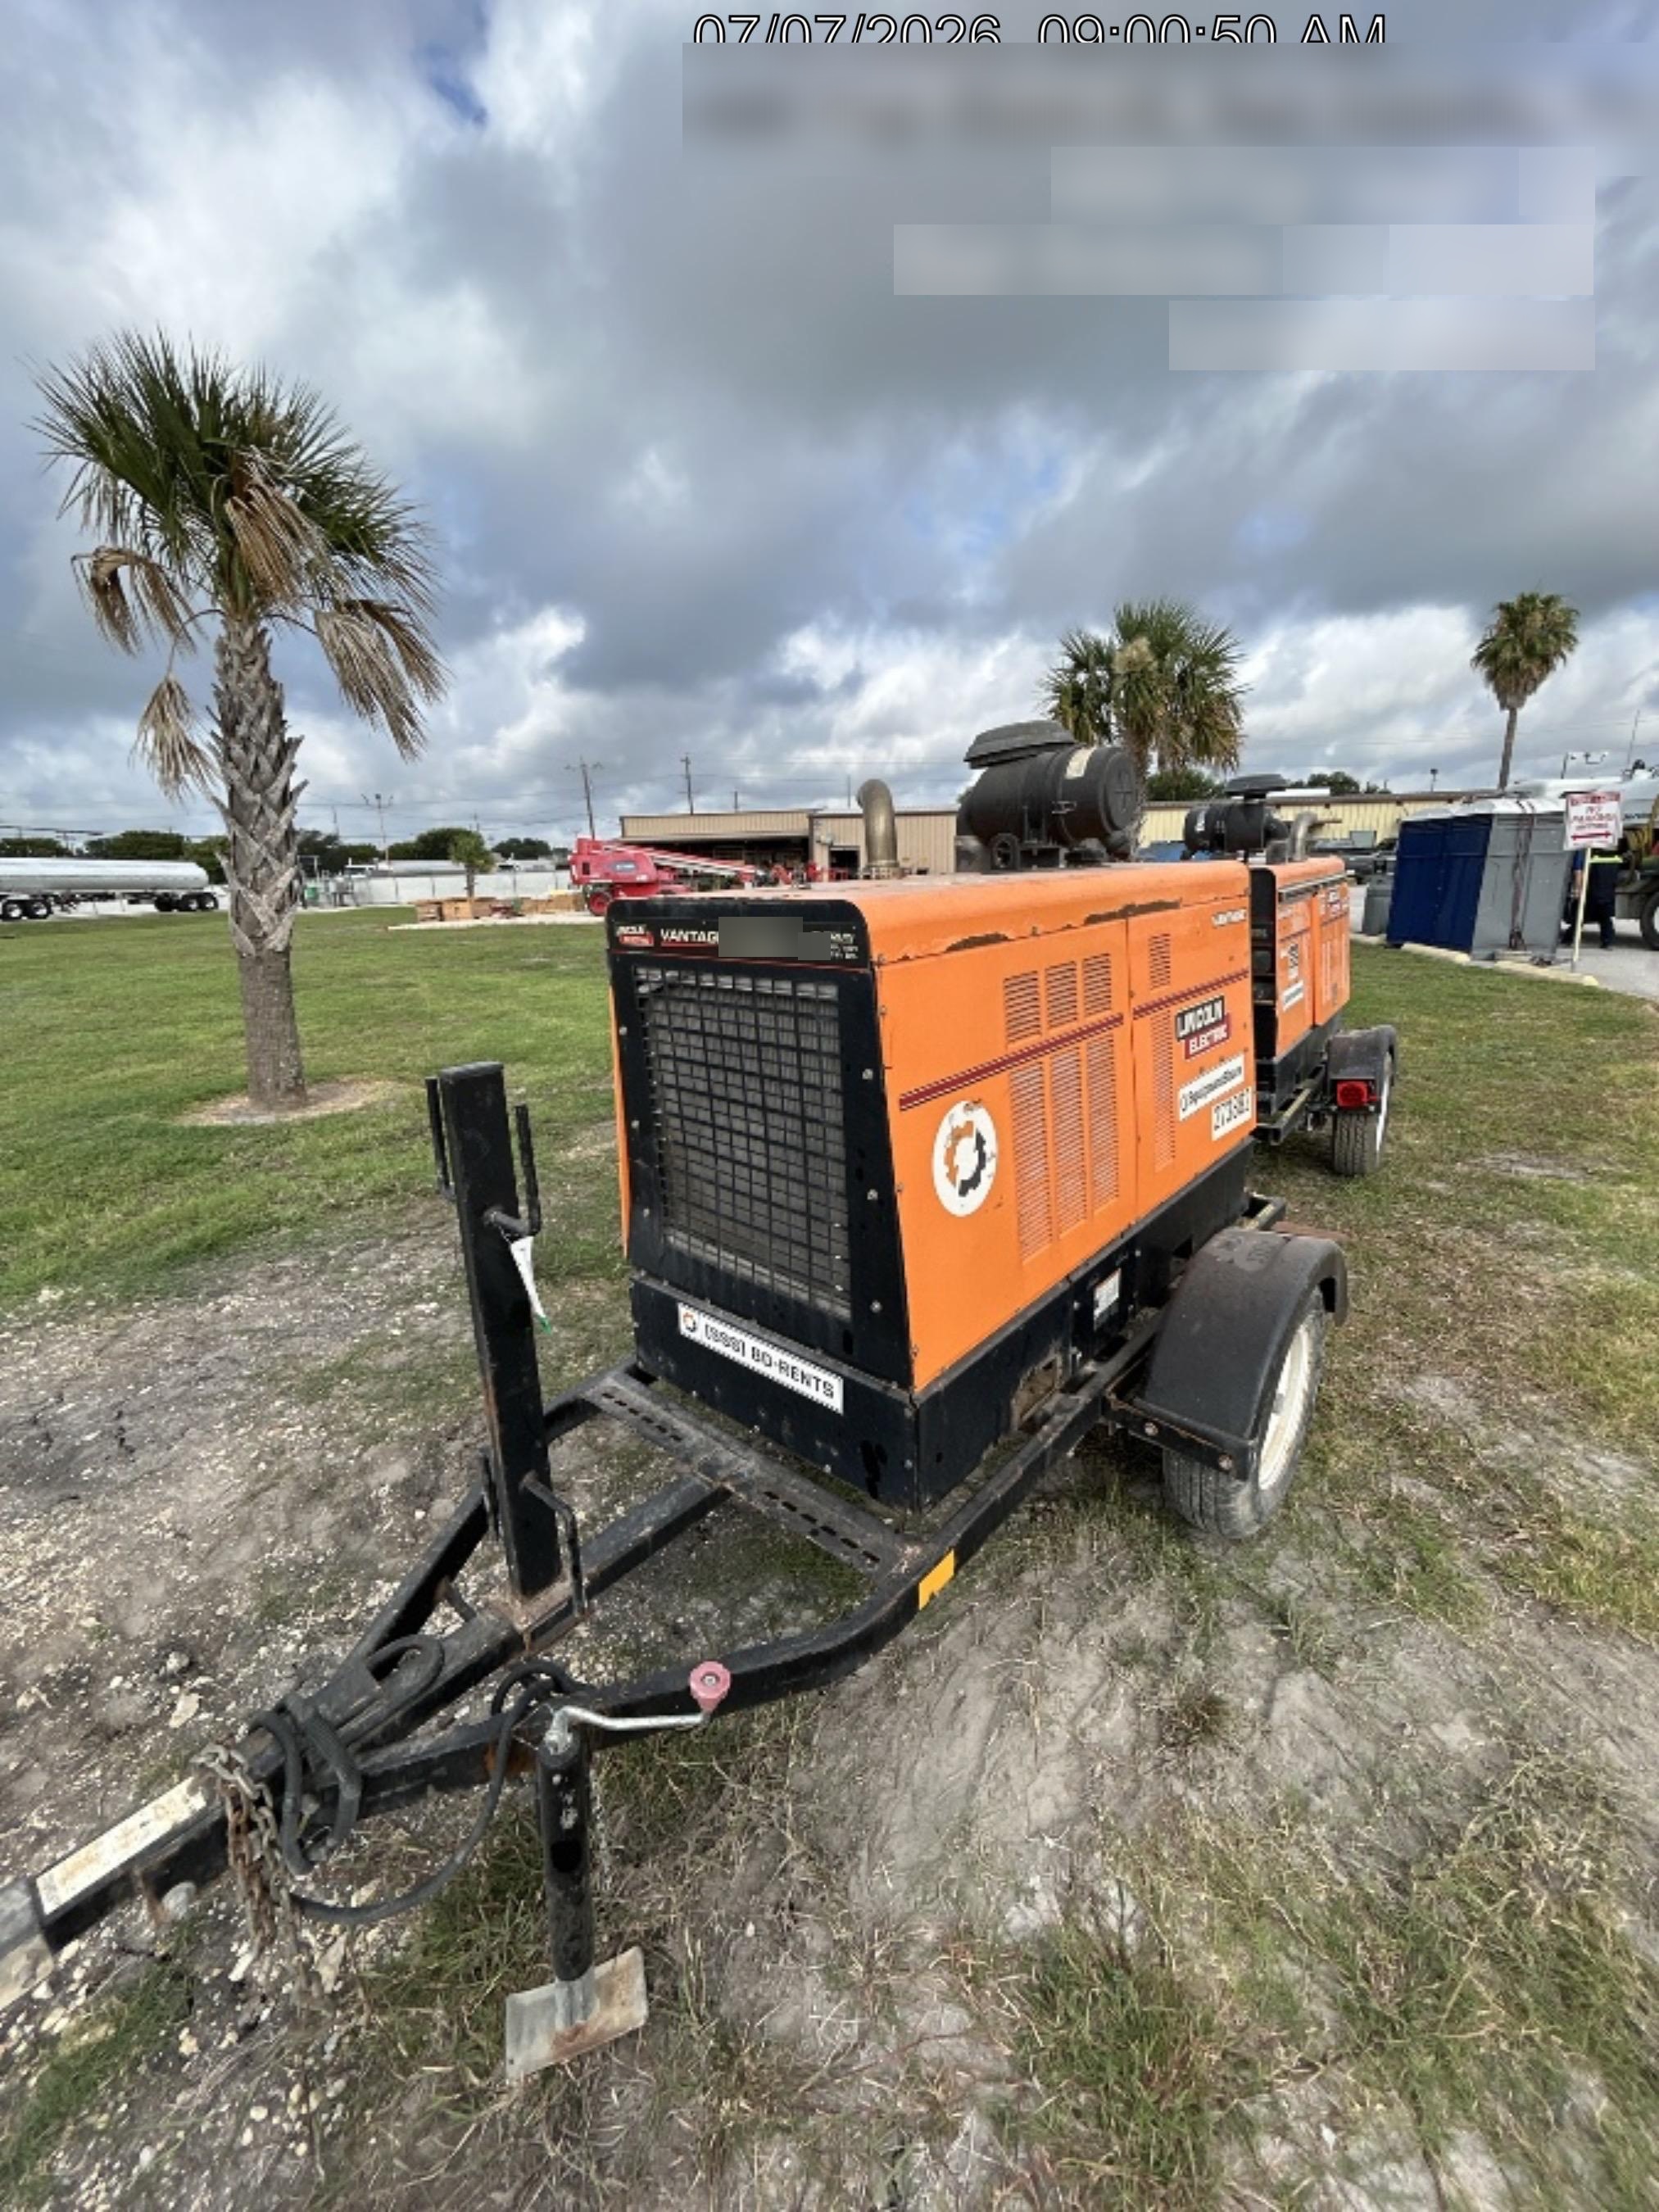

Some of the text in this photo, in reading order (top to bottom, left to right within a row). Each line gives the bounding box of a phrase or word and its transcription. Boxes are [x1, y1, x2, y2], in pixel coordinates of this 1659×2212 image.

[660, 928, 719, 945] VANTAG
[1177, 999, 1224, 1038] LINCOLN
[1190, 1025, 1228, 1055] ELECTRIC
